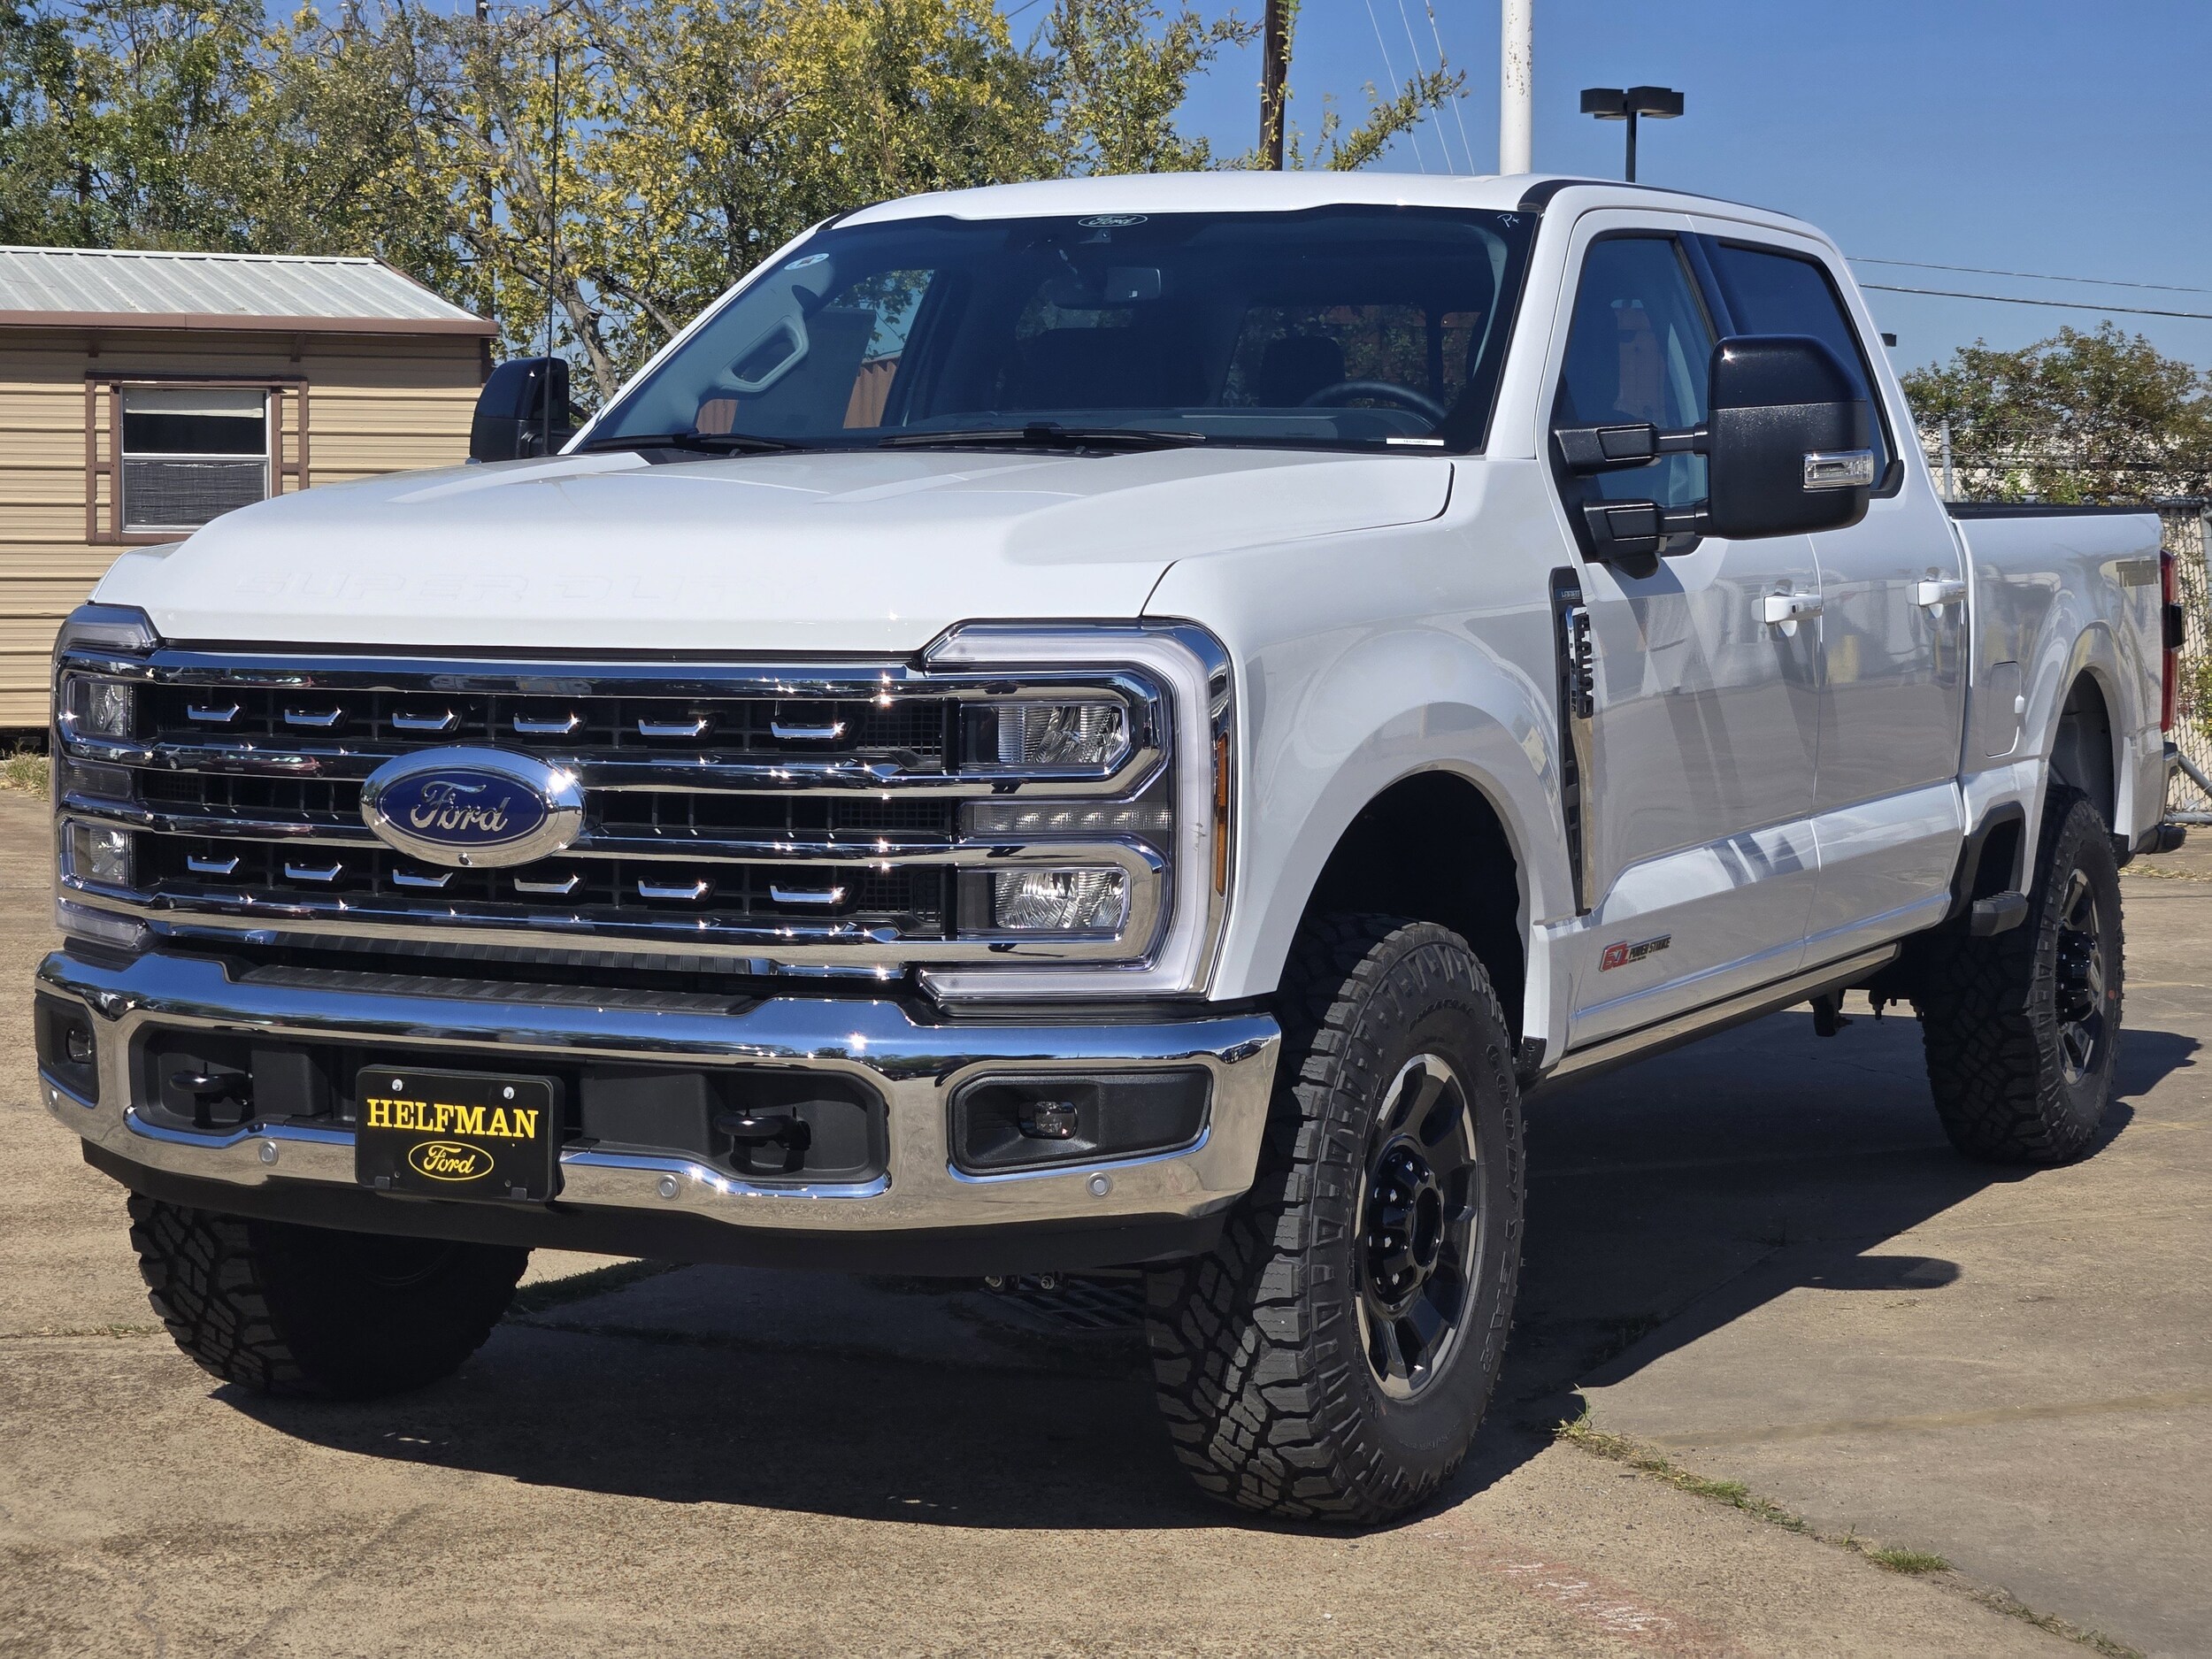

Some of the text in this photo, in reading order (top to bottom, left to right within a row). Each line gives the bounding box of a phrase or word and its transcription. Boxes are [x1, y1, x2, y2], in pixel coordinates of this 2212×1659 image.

[1088, 215, 1137, 226] Ford
[233, 572, 530, 603] SUPER
[410, 780, 511, 833] Ford
[366, 1098, 539, 1139] HELFMAN
[423, 1145, 476, 1174] Ford
[1480, 1043, 1518, 1373] GOODYEAR
